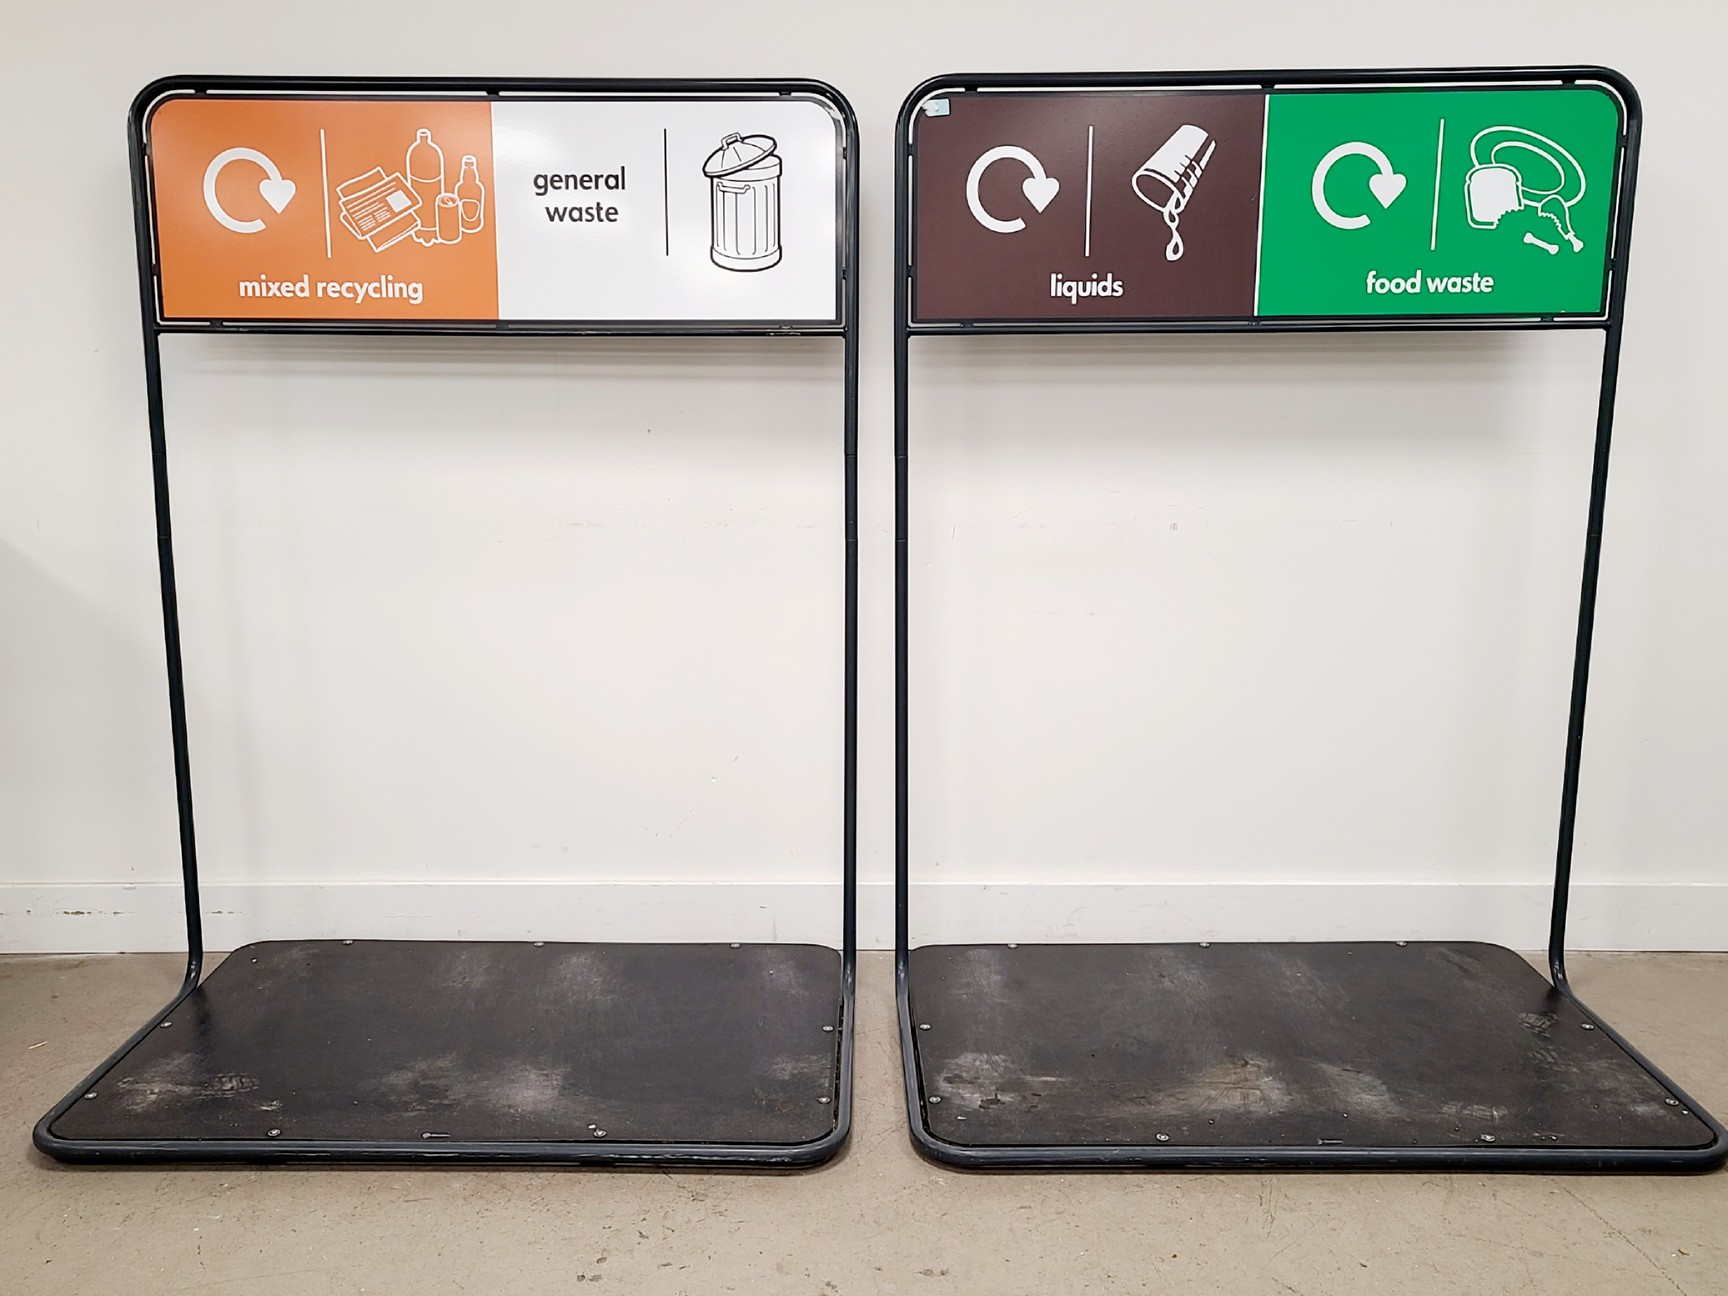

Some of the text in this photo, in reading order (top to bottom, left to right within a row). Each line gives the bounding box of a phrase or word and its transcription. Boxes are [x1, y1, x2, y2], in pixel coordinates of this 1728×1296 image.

[533, 165, 626, 197] general
[545, 201, 619, 223] waste
[238, 274, 424, 305] mixed recycling
[1050, 272, 1124, 304] liquids
[1366, 269, 1495, 294] food waste
